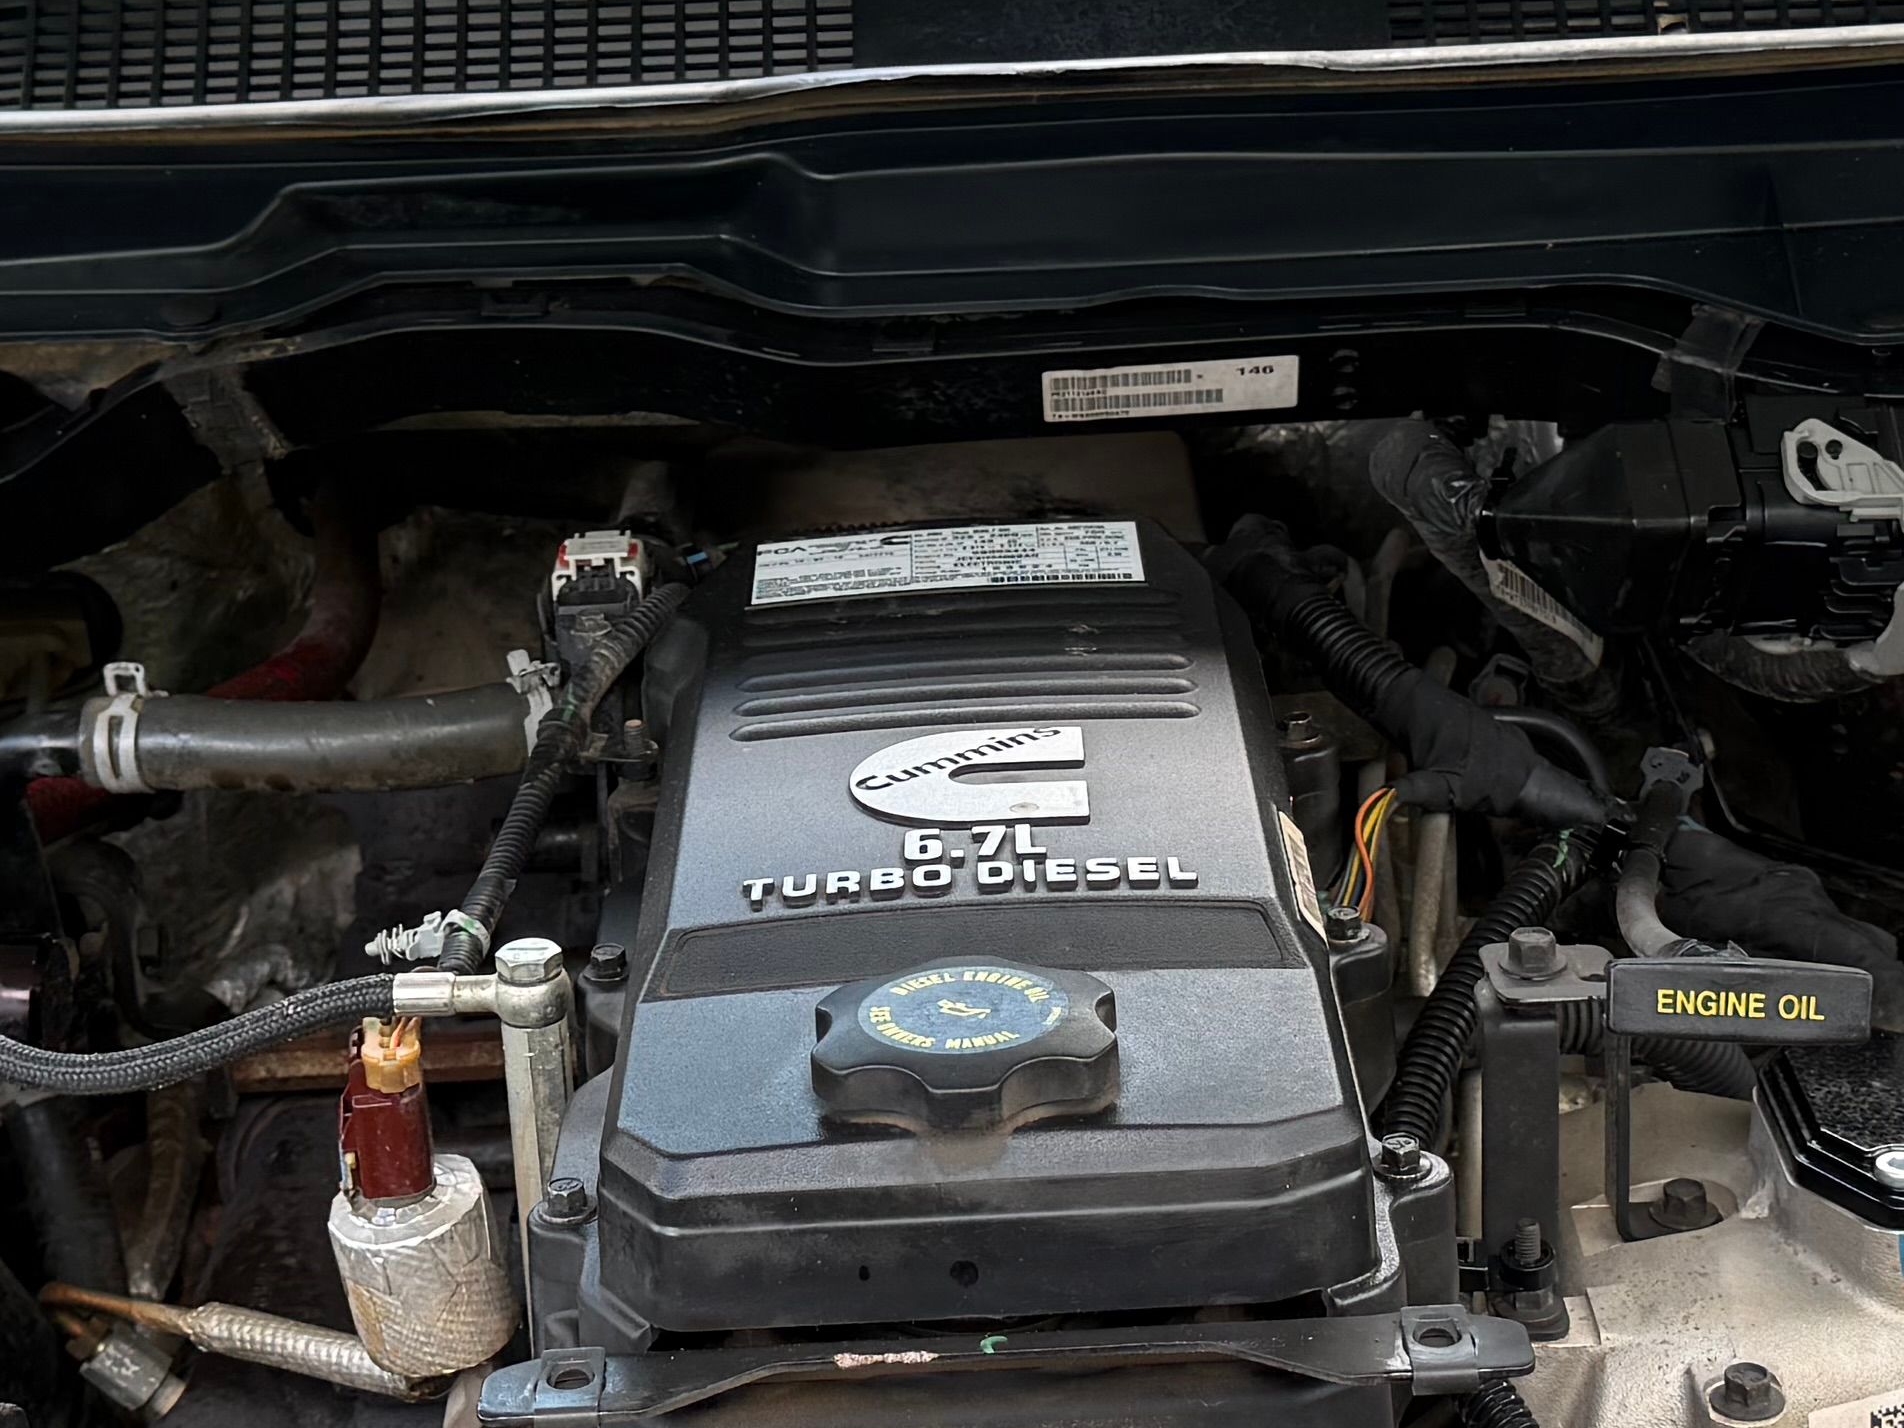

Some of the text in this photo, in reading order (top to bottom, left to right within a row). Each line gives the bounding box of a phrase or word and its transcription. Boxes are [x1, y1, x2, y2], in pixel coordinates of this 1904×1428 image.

[855, 726, 1061, 790] Cummins
[904, 824, 1047, 864] 6.7L
[742, 856, 1199, 909] TURBO DIESEL
[890, 972, 956, 997] DIESEL
[963, 971, 1033, 989] ENGINE
[1657, 989, 1825, 1021] ENGINE OIL
[869, 1006, 892, 1024] SEE
[945, 1030, 1021, 1049] MANUAL
